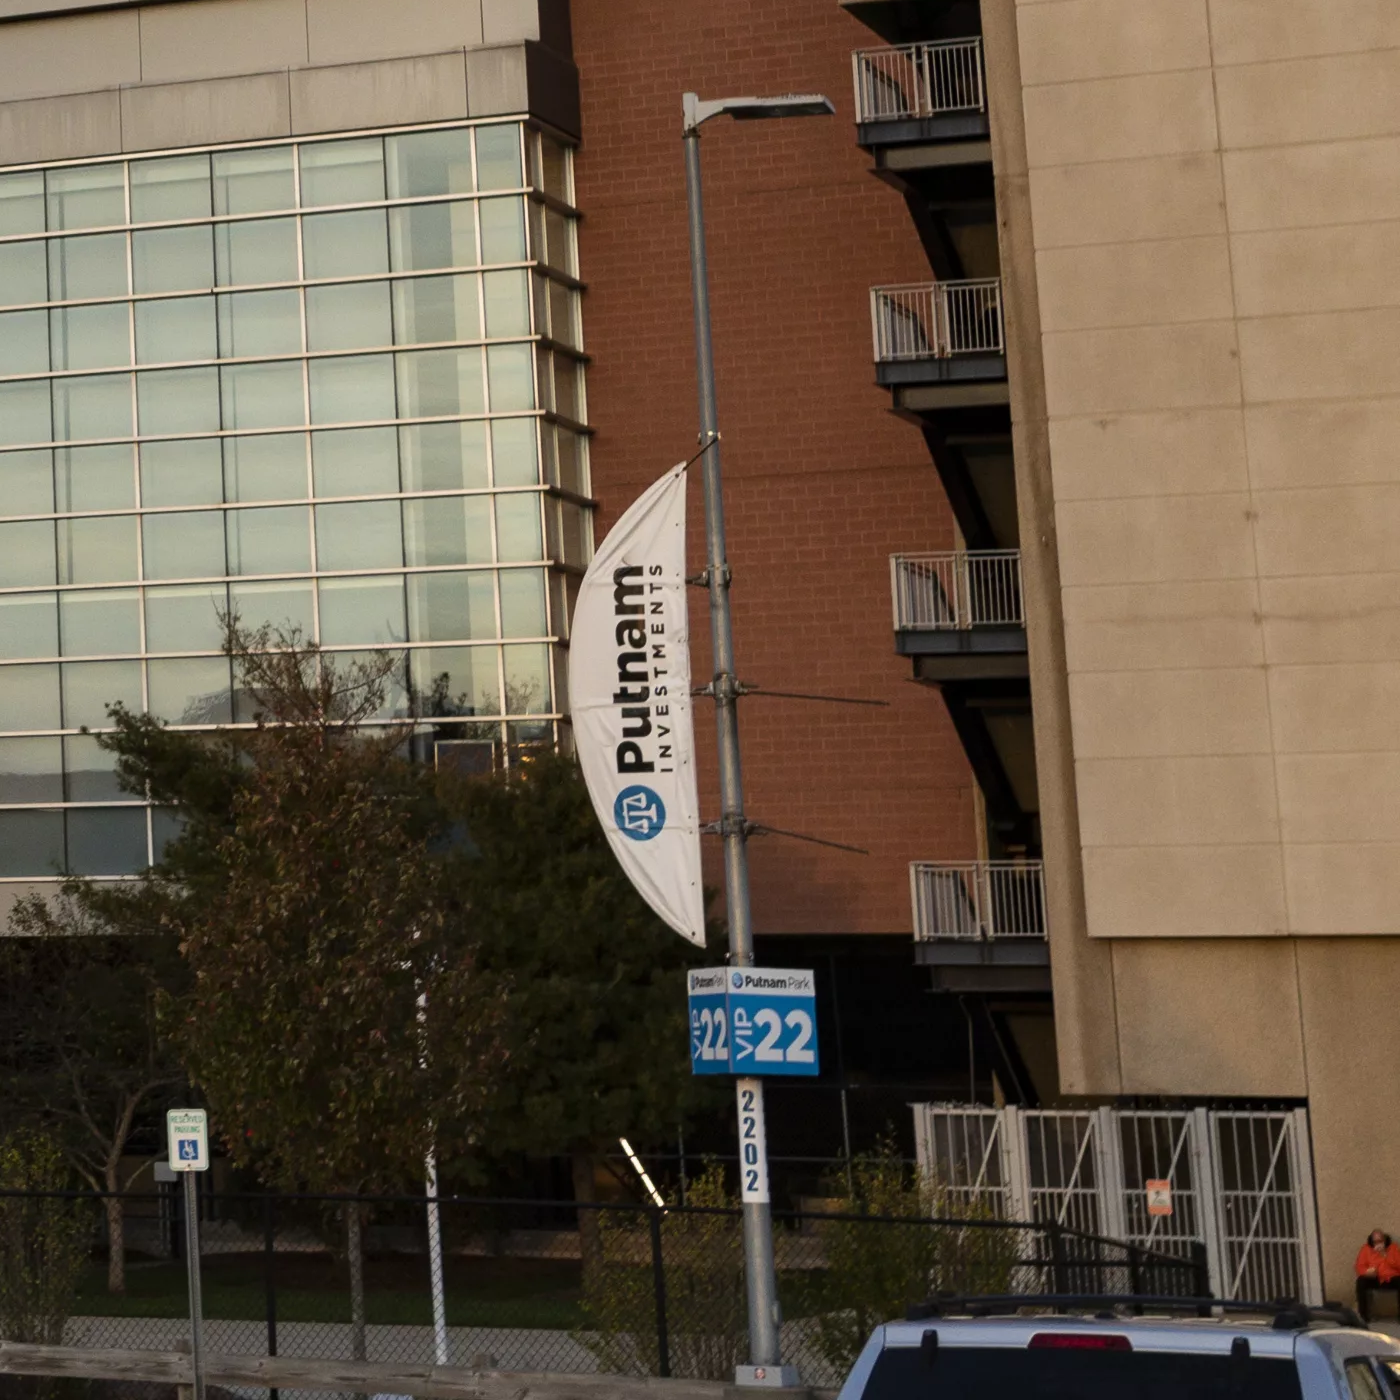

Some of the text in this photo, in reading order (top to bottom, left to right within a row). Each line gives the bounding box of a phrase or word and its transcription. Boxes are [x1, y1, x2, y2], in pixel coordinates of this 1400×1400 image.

[613, 566, 655, 773] Putnam
[649, 565, 673, 772] INVESTMENTS
[745, 975, 810, 990] Putnam Park
[700, 1007, 728, 1060] 22
[734, 1007, 814, 1063] VIP 22
[741, 1090, 759, 1192] 2202
